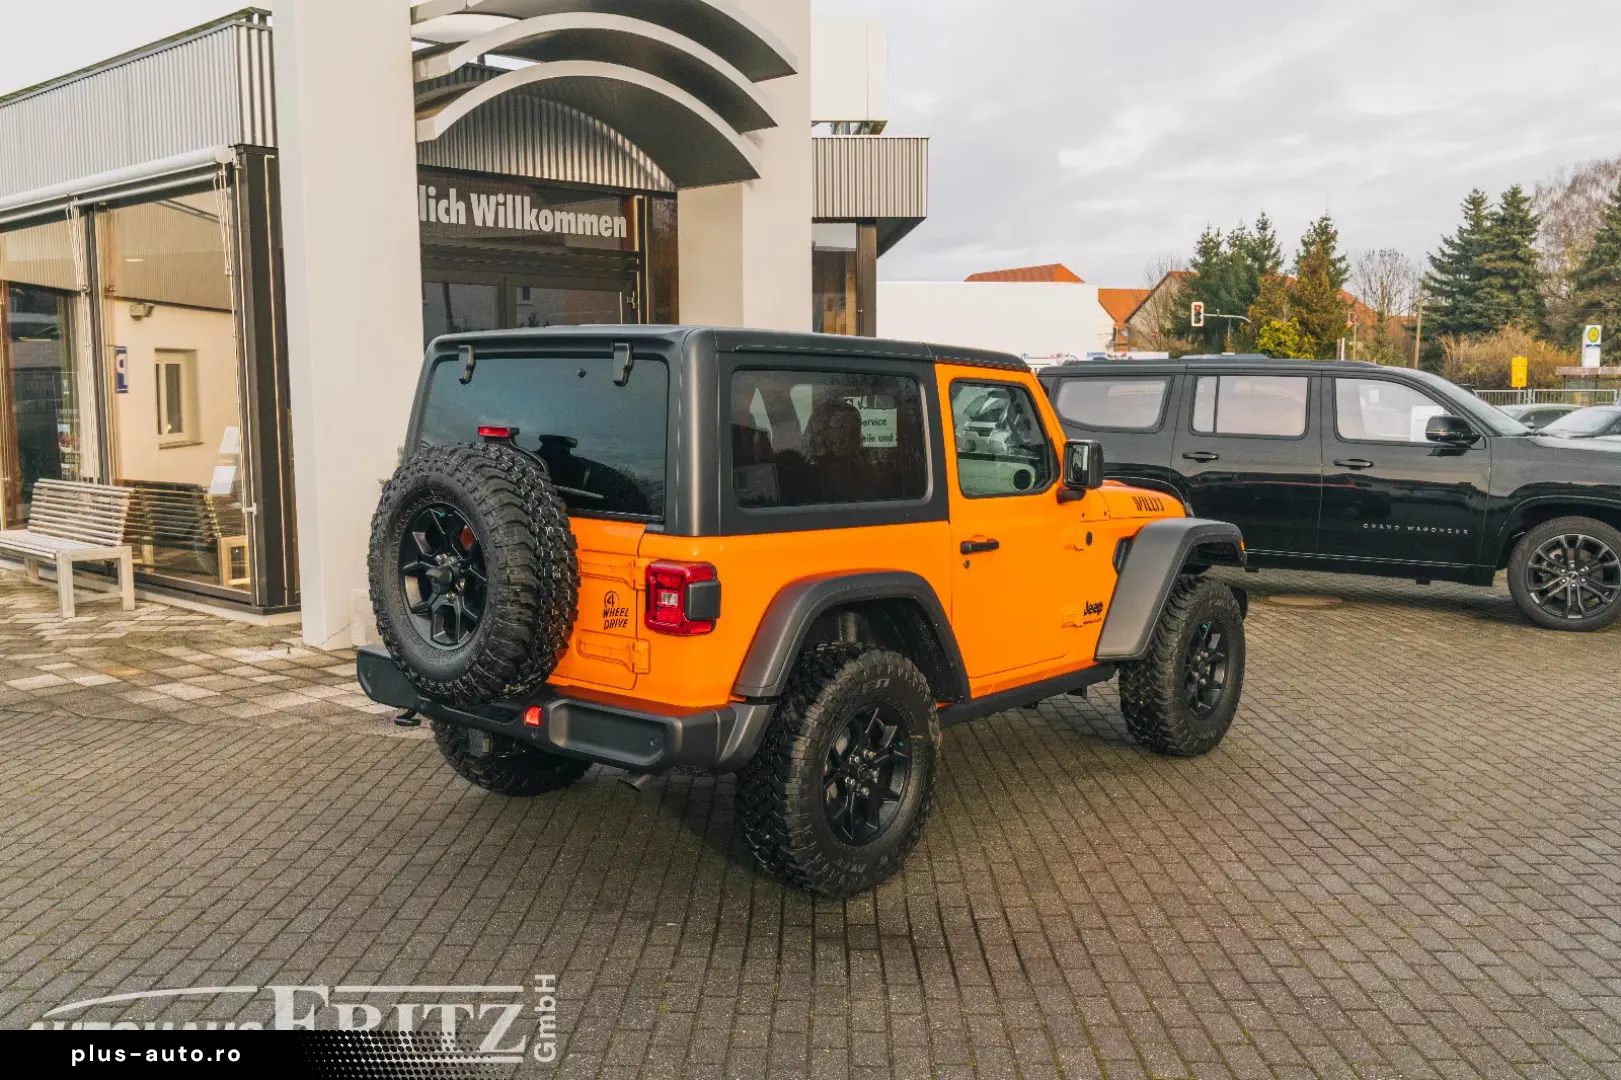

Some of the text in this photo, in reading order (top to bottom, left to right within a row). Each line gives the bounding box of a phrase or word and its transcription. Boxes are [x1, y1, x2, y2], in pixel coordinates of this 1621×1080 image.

[470, 193, 627, 237] Willkommen
[860, 417, 887, 427] ervice
[860, 432, 894, 443] eile und
[1131, 496, 1165, 512] WILLYS
[1363, 523, 1468, 535] GRAND WAGONEER
[602, 607, 629, 618] WHEEL
[1083, 600, 1104, 616] Jeep
[603, 618, 628, 630] DRIVE
